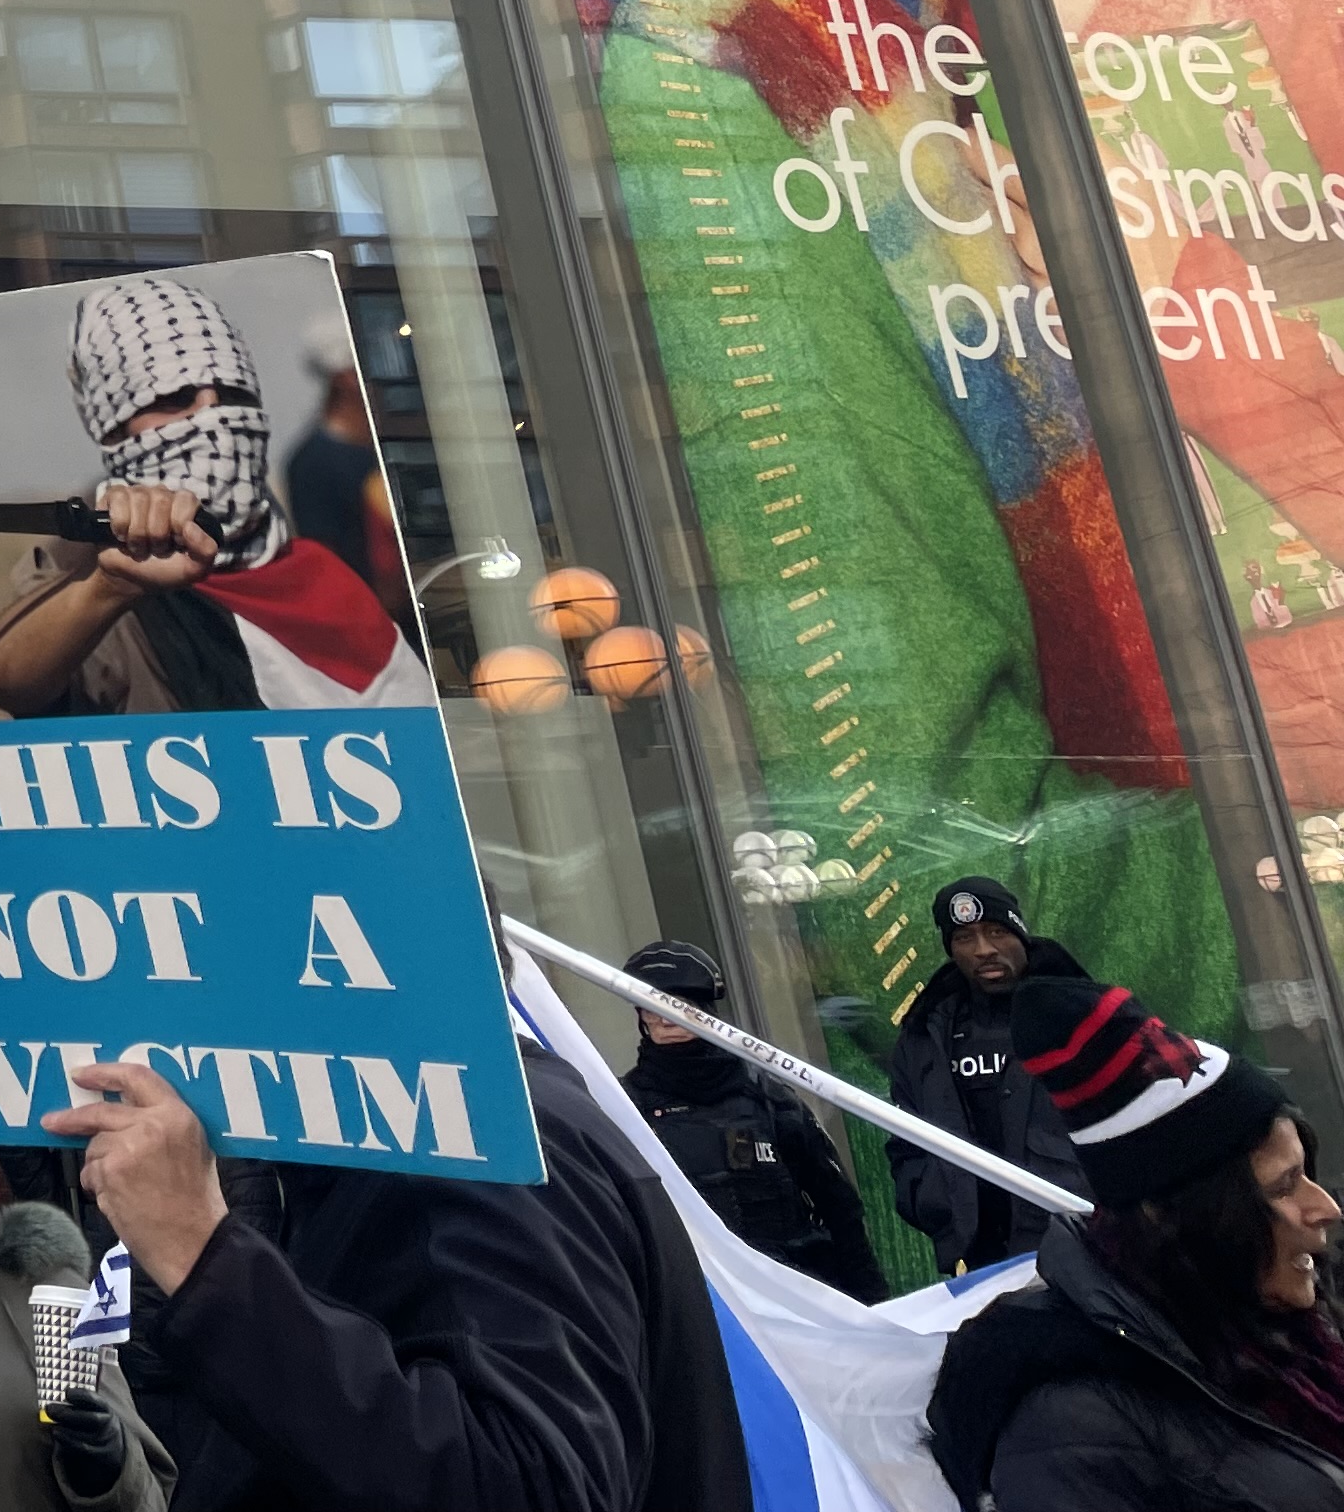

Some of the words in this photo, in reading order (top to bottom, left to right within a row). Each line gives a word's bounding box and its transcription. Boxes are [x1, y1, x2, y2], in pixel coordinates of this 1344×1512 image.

[1064, 30, 1237, 105] ore
[772, 107, 869, 233] of
[899, 113, 1344, 243] Chstmas
[928, 265, 1285, 399] preent
[252, 731, 403, 831] IS
[298, 895, 397, 991] A
[650, 987, 738, 1038] PROPERTY
[741, 1035, 768, 1056] OF
[951, 1053, 1006, 1076] OLI
[755, 1141, 777, 1163] LICE
